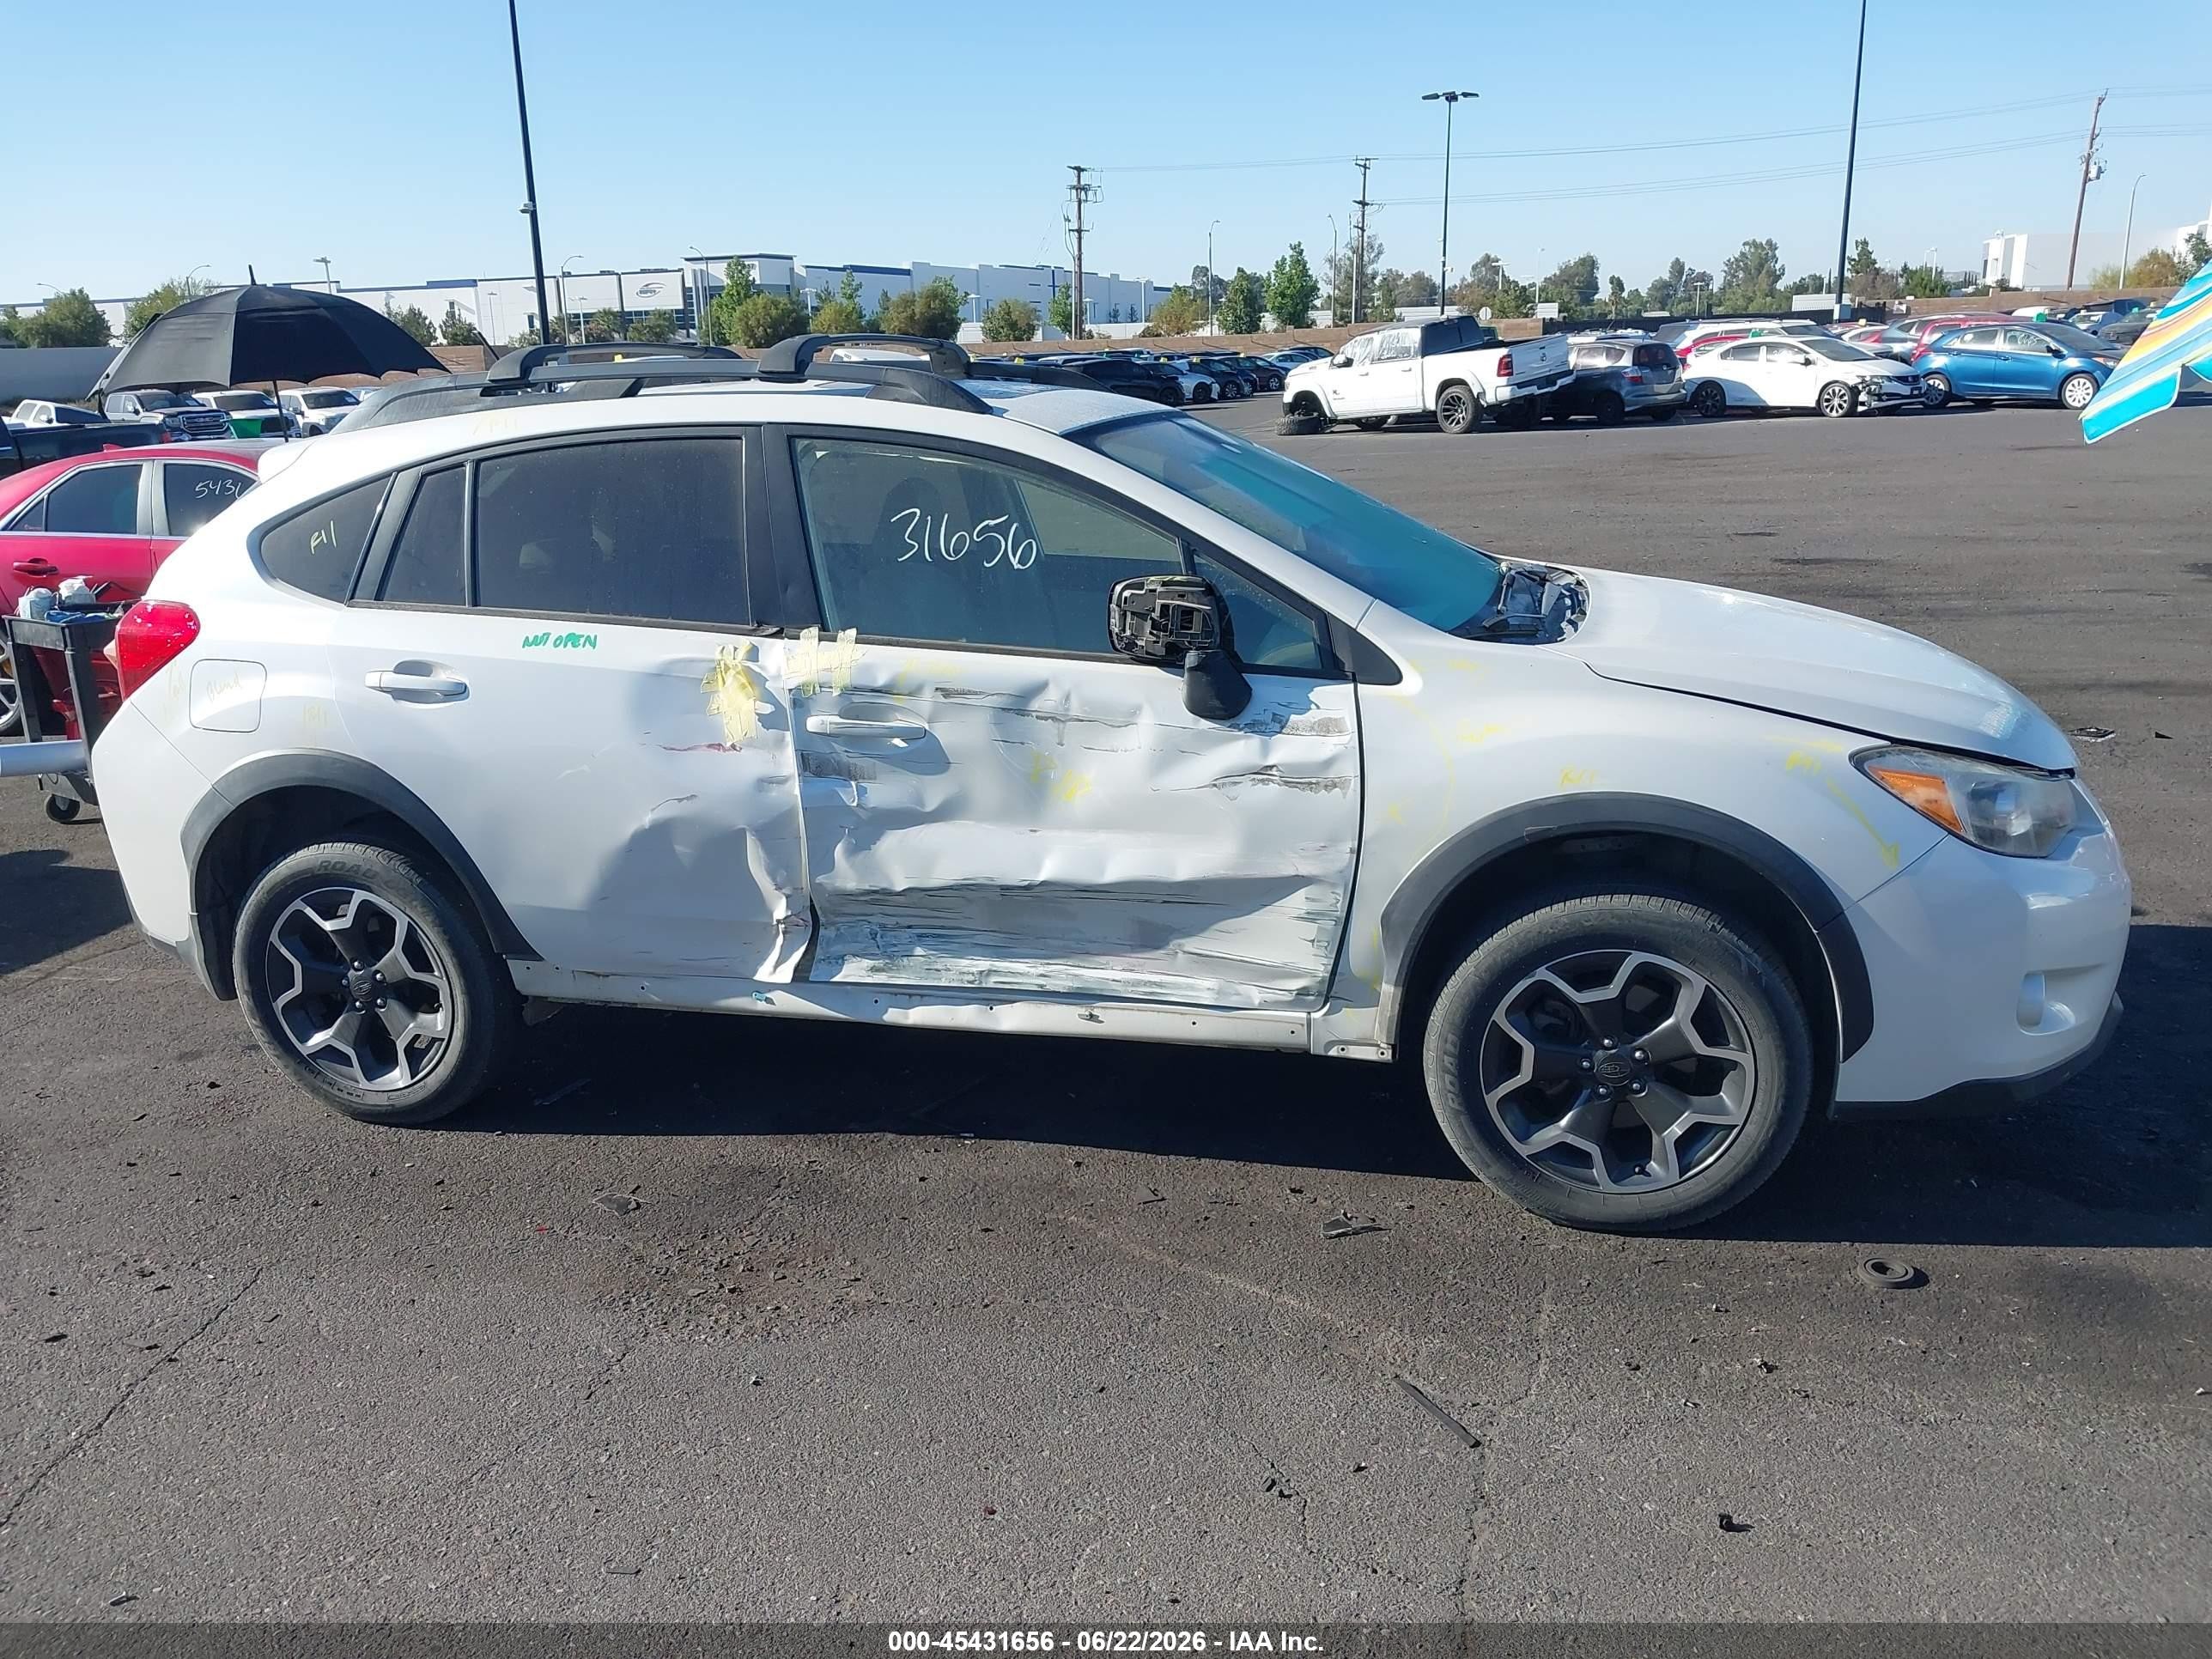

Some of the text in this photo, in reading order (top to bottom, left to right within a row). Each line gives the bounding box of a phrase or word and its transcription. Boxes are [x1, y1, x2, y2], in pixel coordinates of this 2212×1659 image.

[890, 507, 1036, 569] 31656
[553, 633, 598, 649] OPEN
[317, 860, 379, 880] ROAD
[1442, 1032, 1466, 1111] ROAD
